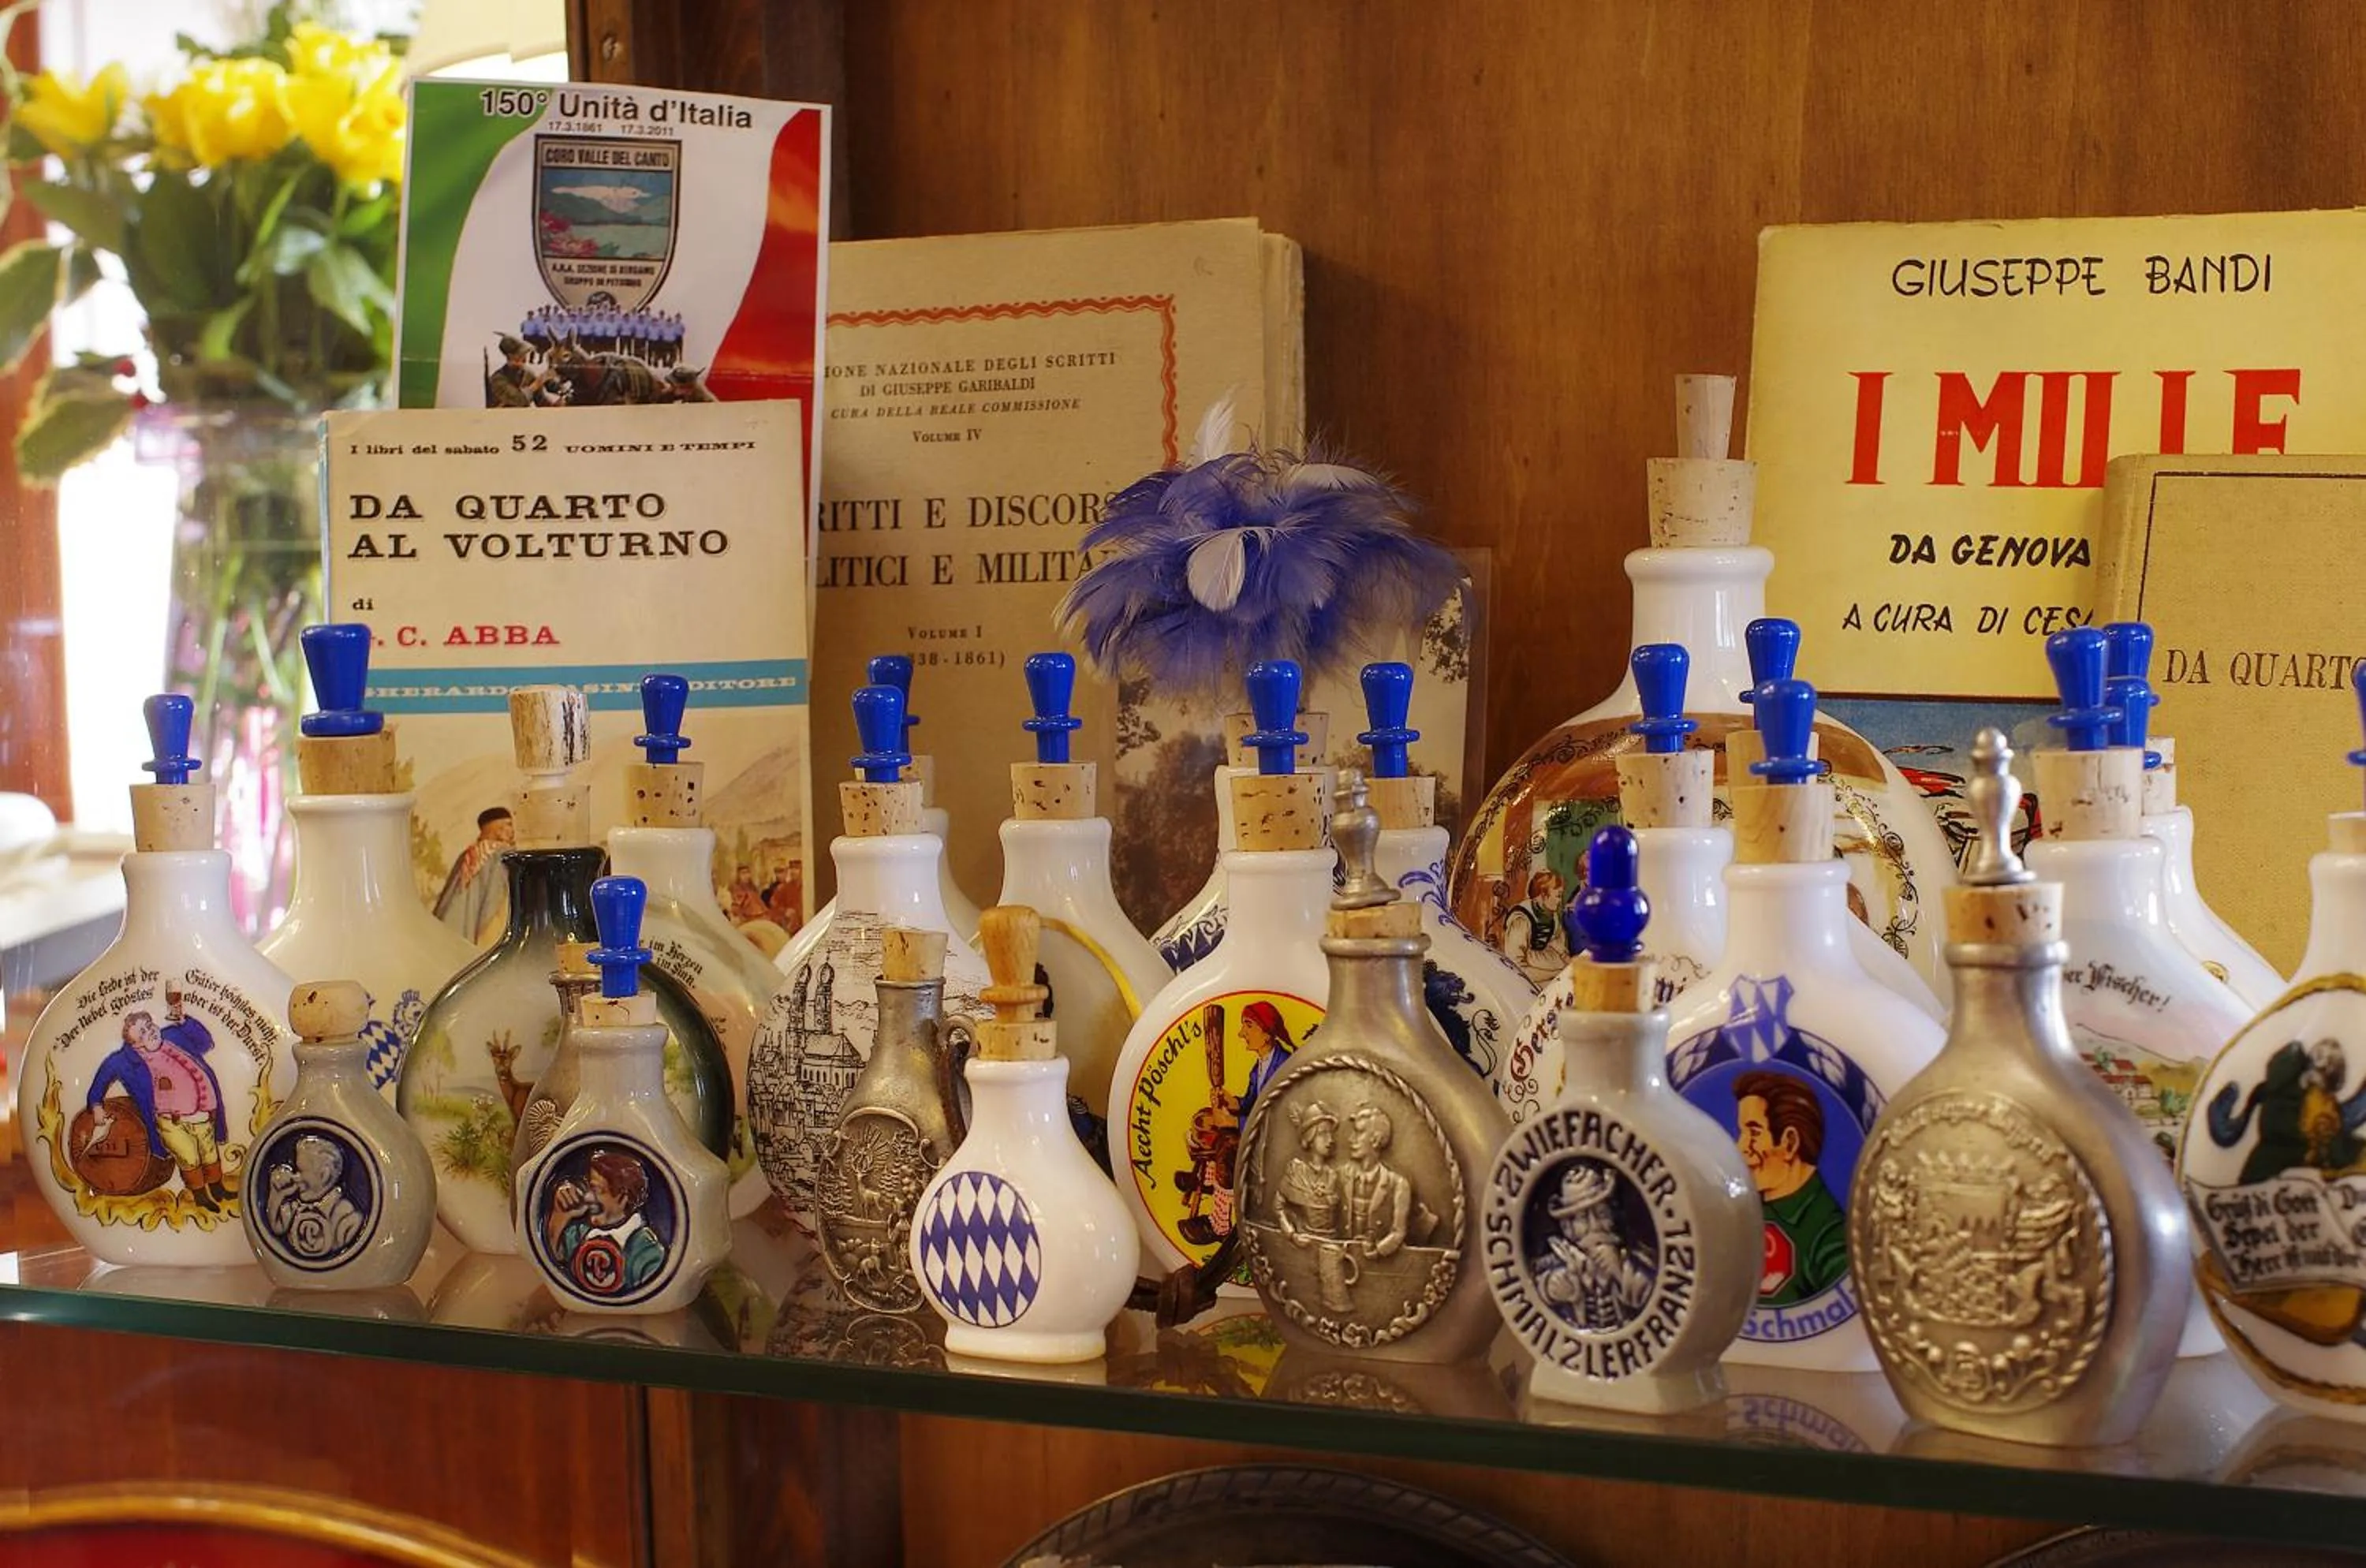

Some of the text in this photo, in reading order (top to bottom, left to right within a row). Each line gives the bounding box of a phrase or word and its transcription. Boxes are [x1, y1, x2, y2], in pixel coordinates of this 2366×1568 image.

[480, 89, 752, 129] 150° Unità d'Italia
[548, 121, 674, 136] 17.3.1861 17.3.2011
[546, 148, 669, 166] CORO VALLE DEL CANTO
[1892, 253, 2271, 297] GIUSEPPE BANDI
[875, 359, 976, 377] NAZIONALE
[984, 356, 1037, 371] DEGLI
[1045, 352, 1115, 368] SCRITTI
[860, 377, 1035, 397] DI GIUSEPPE GARIBALDI
[830, 398, 1081, 419] CURA DELLA REALE COMMISSIONE
[967, 428, 982, 441] IV
[1844, 371, 1894, 486] I
[350, 435, 756, 454] I libri del sabato 52 UOMINI E TEMPI
[349, 493, 665, 520] DA QUARTO
[924, 498, 946, 528] E
[347, 529, 728, 558] AL VOLTURNO
[1889, 534, 2091, 568] DA GENOVA
[931, 554, 953, 585] E
[976, 550, 1117, 584] MILITA
[352, 598, 374, 610] di
[976, 625, 982, 638] I
[1842, 603, 1861, 631] A
[1873, 603, 1953, 633] CURA
[1977, 606, 2010, 635] DI
[397, 626, 427, 646] C.
[442, 625, 561, 645] ABBA
[2162, 649, 2211, 684] DA
[689, 677, 796, 691] DITORE
[1131, 1021, 1202, 1190] Aecht Pöschl's
[1495, 1111, 1677, 1206] ZWIEFACHER
[1742, 1283, 1857, 1338] Schmal
